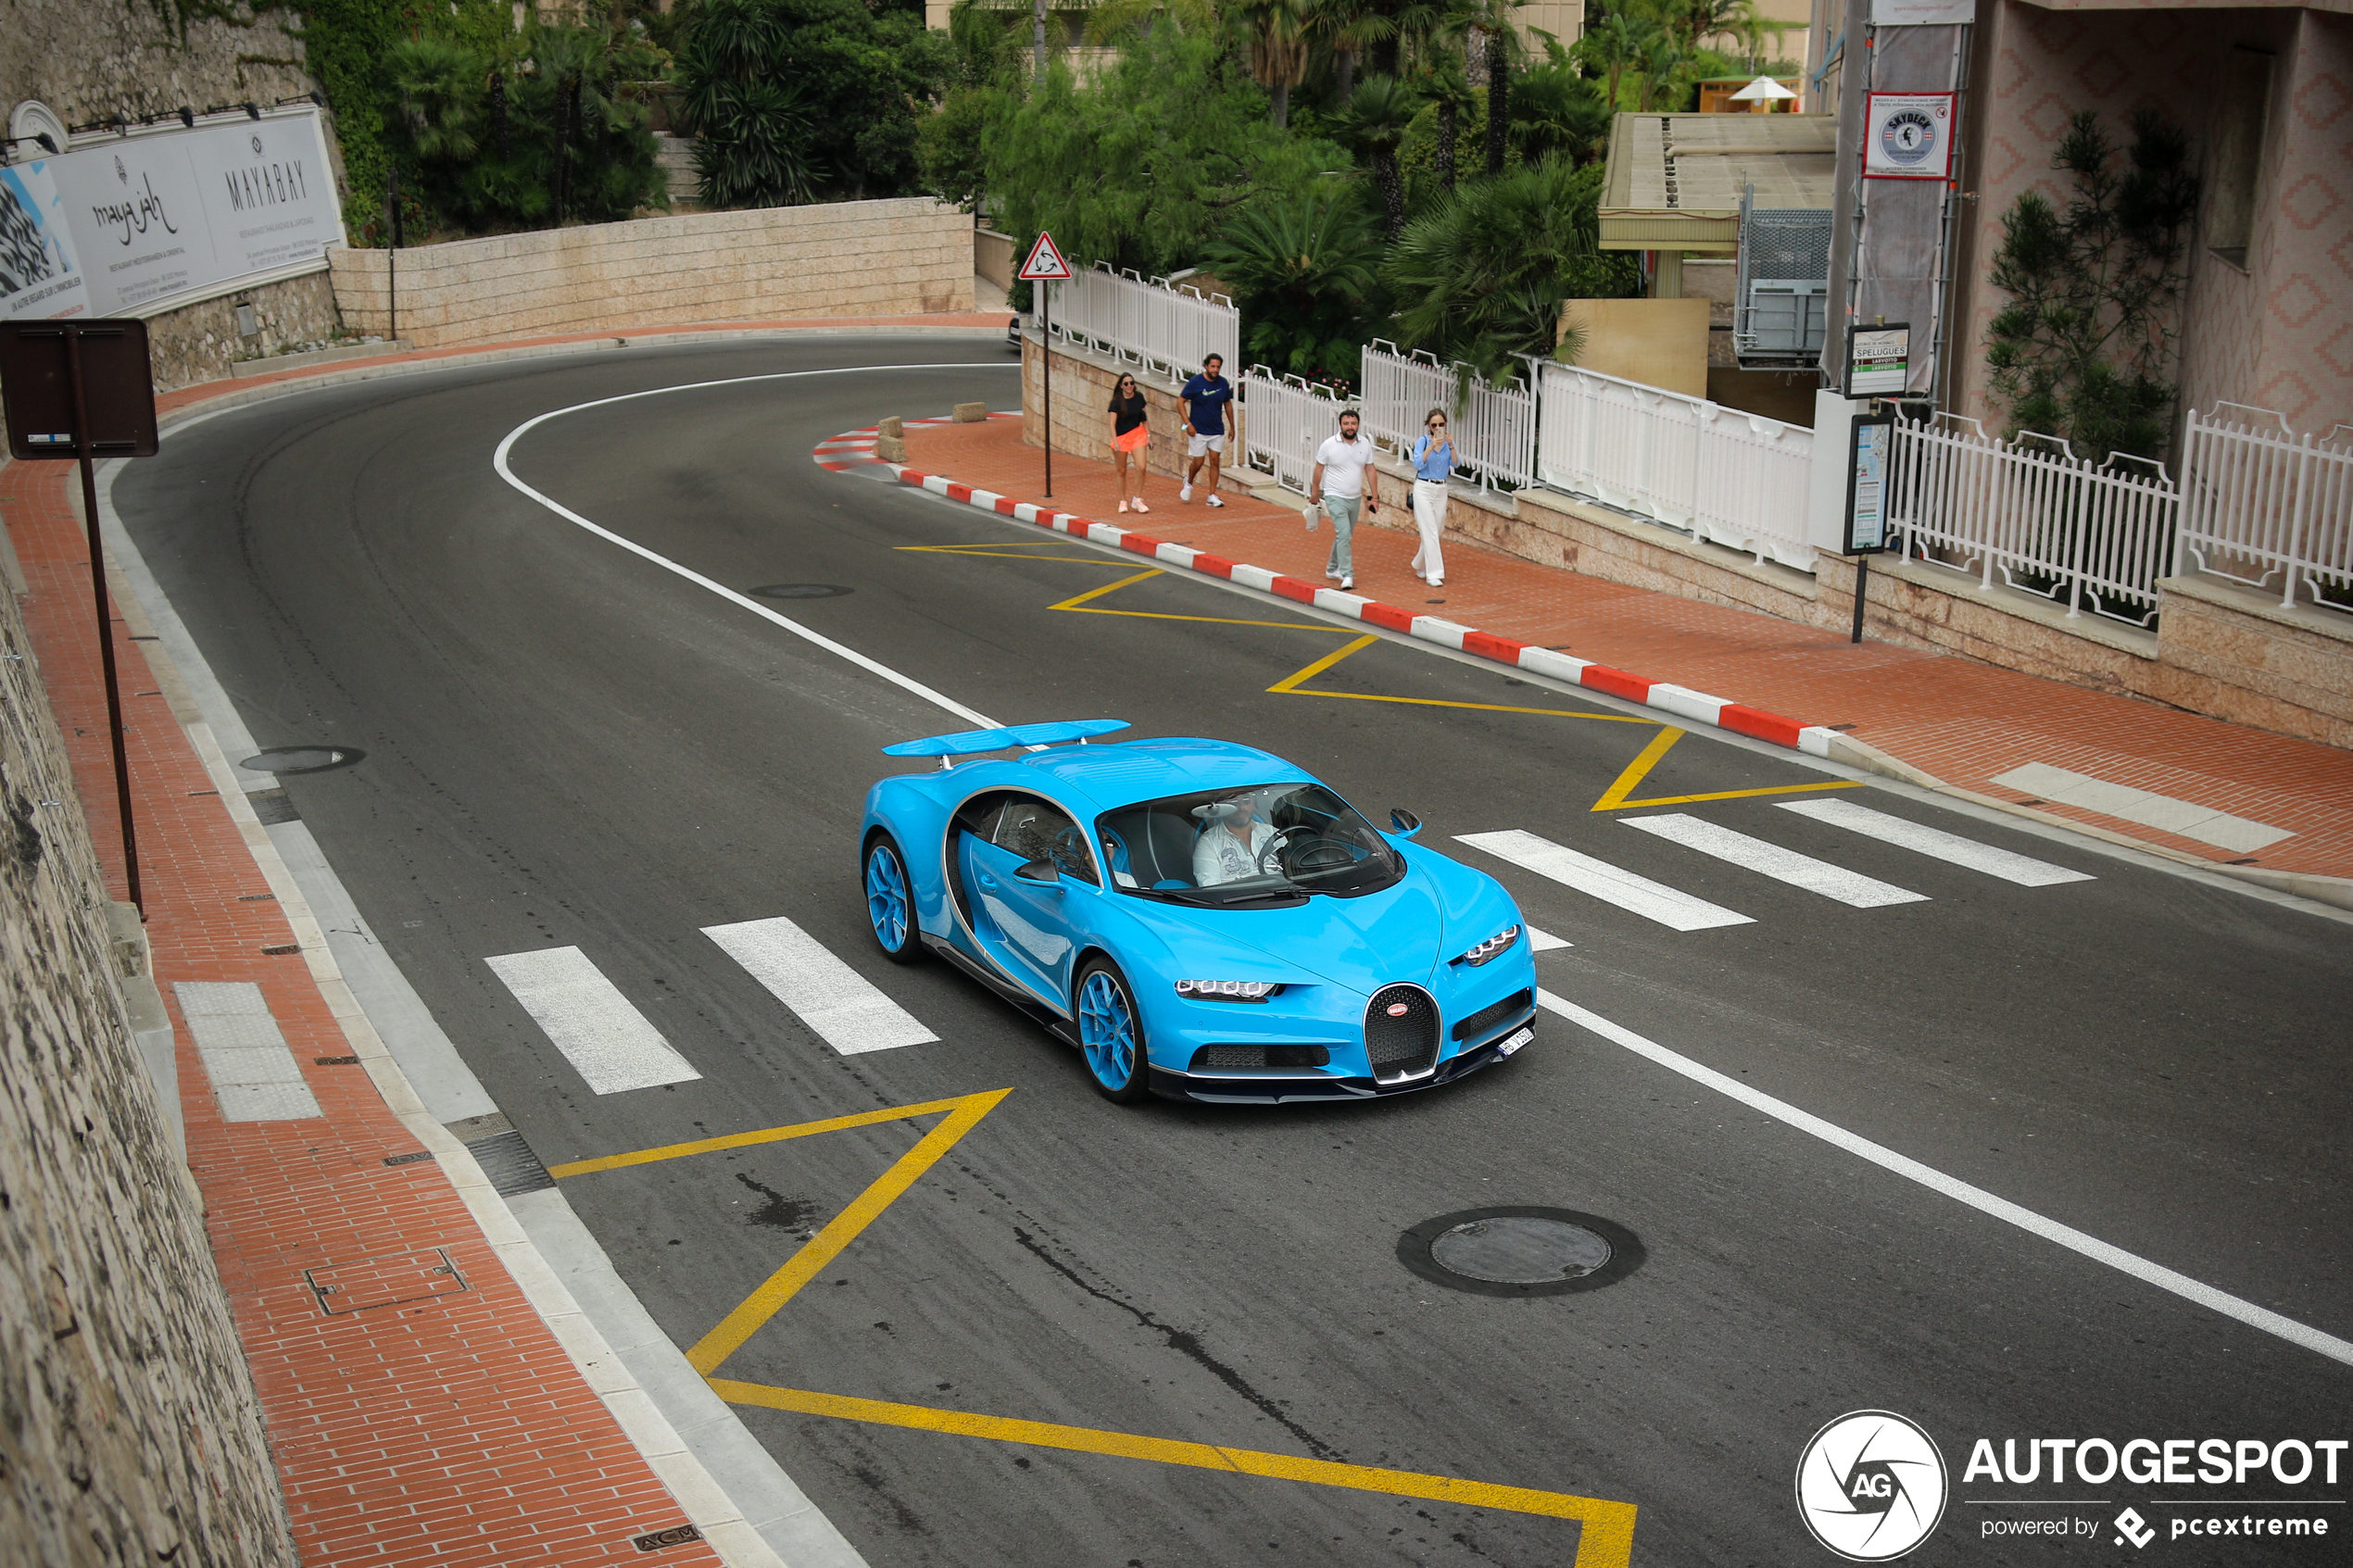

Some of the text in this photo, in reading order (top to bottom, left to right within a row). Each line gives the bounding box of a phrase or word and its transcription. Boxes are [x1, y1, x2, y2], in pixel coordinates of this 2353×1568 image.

[1888, 113, 1931, 130] SKYDECK
[224, 159, 307, 212] MAYABAY
[17, 295, 30, 308] AUTRE
[28, 290, 45, 304] REGARD
[44, 286, 54, 297] SUR
[1856, 347, 1906, 358] SPELUGUES
[1221, 847, 1241, 872] 3
[640, 1528, 697, 1549] ACM
